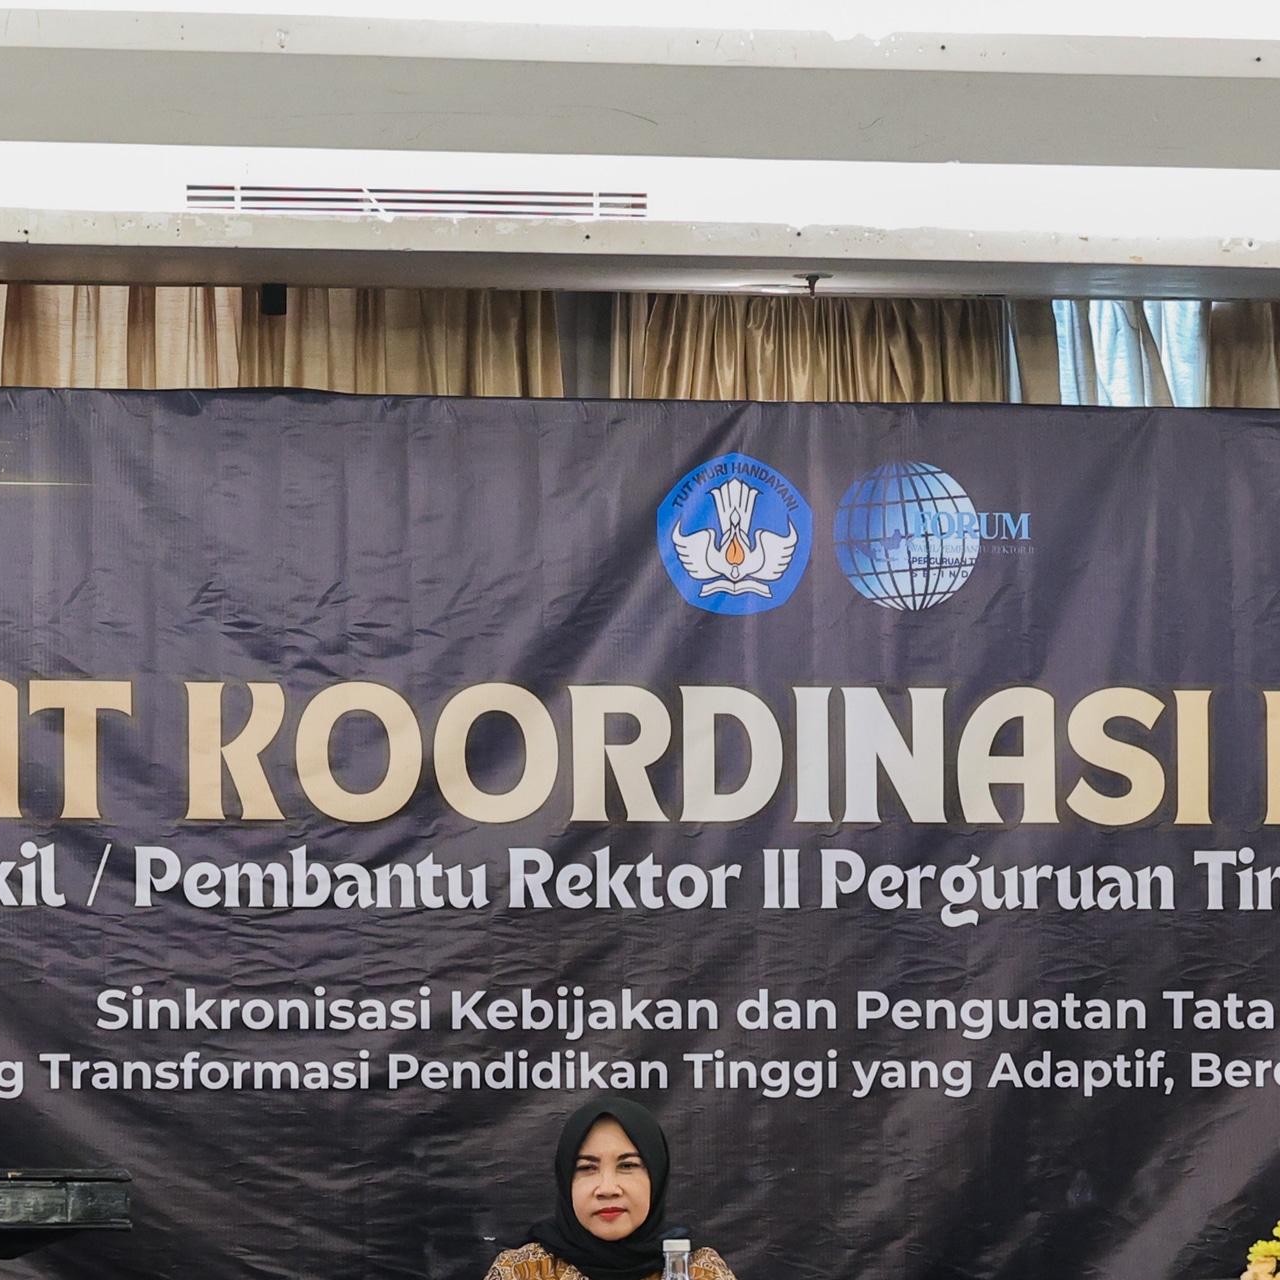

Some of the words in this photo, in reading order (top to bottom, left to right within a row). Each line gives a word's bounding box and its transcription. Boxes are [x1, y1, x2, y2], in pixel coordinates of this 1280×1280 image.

[672, 481, 694, 508] TUT
[693, 463, 728, 486] WURI
[731, 462, 799, 511] HANDAYANI
[914, 511, 1031, 540] FORUM
[184, 681, 1213, 827] KOORDINASI
[86, 843, 112, 907] /
[134, 845, 490, 910] Pembantu
[508, 846, 742, 910] Rektor
[761, 848, 801, 909] II
[820, 848, 1175, 928] Perguruan
[96, 986, 430, 1031] Sinkronisasi
[451, 987, 718, 1040] Kebijakan
[736, 990, 837, 1031] dan
[857, 991, 1147, 1040] Penguatan
[1162, 991, 1275, 1030] Tata
[40, 1050, 370, 1090] Transformasi
[388, 1049, 668, 1090] Pendidikan
[683, 1049, 838, 1098] Tinggi
[852, 1060, 973, 1098] yang
[988, 1049, 1175, 1096] Adaptif,
